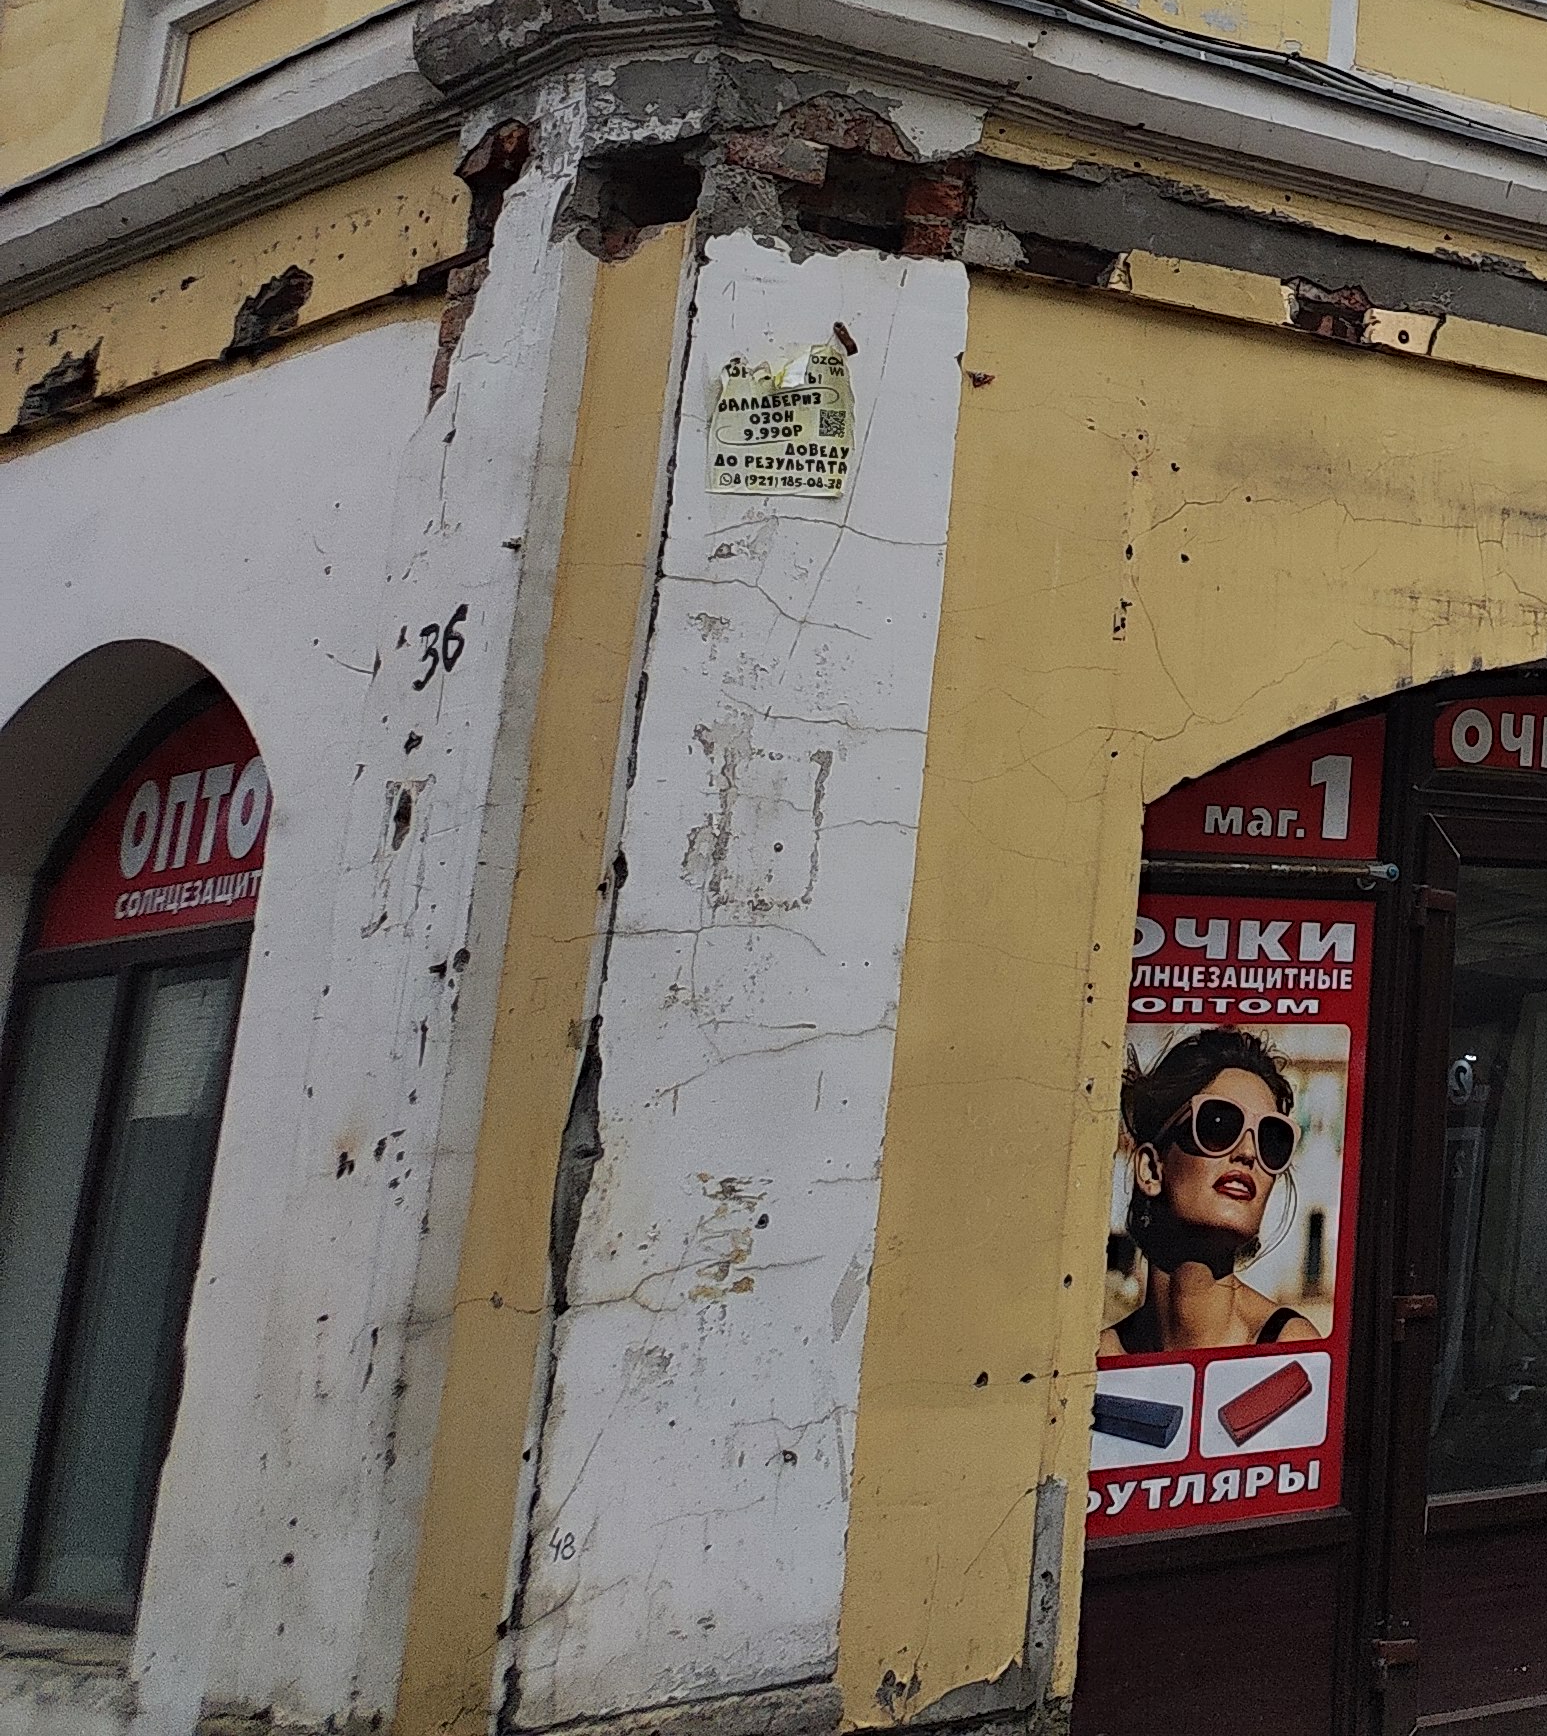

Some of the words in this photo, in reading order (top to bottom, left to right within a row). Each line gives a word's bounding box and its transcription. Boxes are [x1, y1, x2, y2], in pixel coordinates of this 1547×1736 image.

[749, 410, 794, 425] ОЗОН
[785, 443, 850, 460] ДОВЕДУ
[714, 453, 738, 467] ДО
[744, 455, 848, 475] РЕЗУЛЬТАТА
[412, 604, 470, 692] 36
[1204, 805, 1306, 838] маг.
[1311, 755, 1353, 840] 1
[1131, 965, 1353, 991] ЛНЦЕЗАЩИТНЫЕ
[1131, 997, 1320, 1014] ОПТОМ
[548, 1526, 576, 1562] 48
